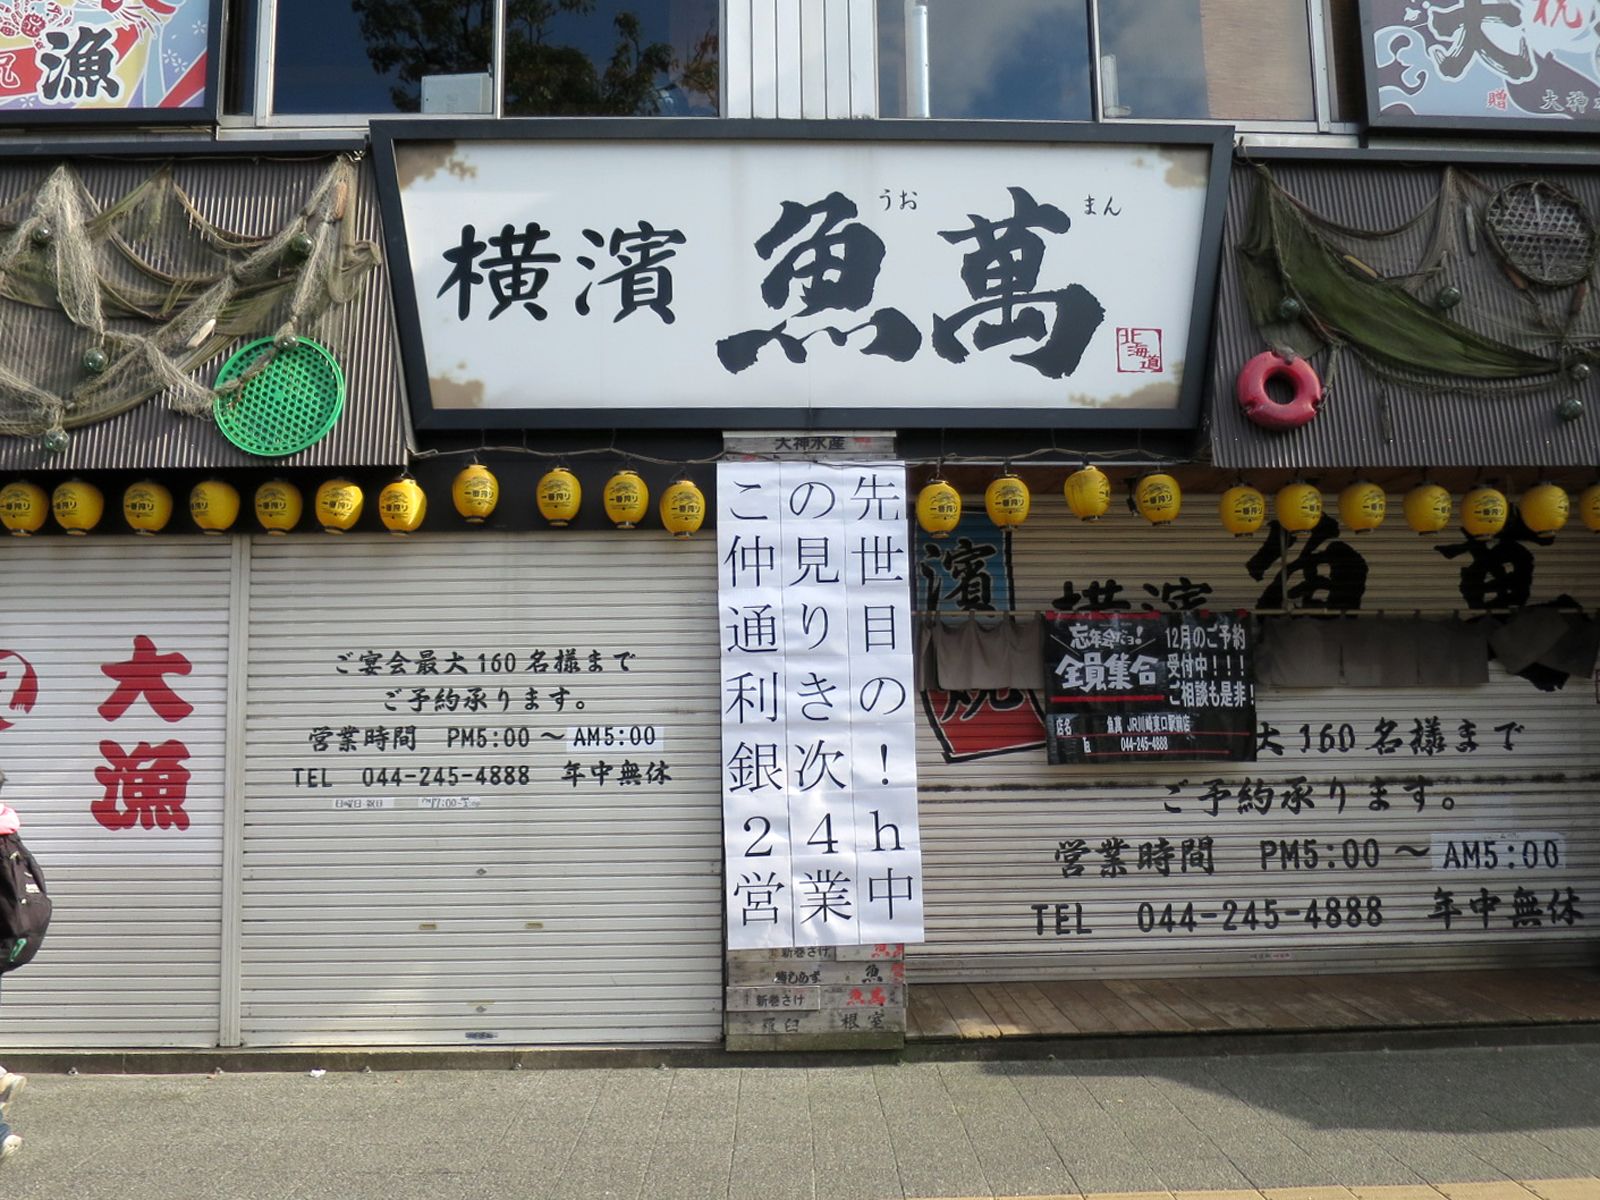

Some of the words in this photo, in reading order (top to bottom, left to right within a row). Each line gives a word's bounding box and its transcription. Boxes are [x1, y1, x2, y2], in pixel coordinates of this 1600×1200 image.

[879, 189, 918, 211] うお
[1083, 194, 1122, 216] まん
[1119, 331, 1159, 370] 北海道
[729, 474, 901, 521] この先
[724, 535, 904, 588] 仲見世
[726, 602, 898, 654] 通り目
[1055, 652, 1160, 693] 全員集合
[384, 687, 586, 712] ご予約承ります。
[725, 671, 907, 724] 利きの
[91, 635, 195, 831] 大漁
[308, 725, 417, 752] 営業時間
[293, 767, 334, 788] TEL
[362, 765, 530, 787] 044-245-4888
[560, 760, 673, 788] 年中無休
[1164, 773, 1456, 817] ご予約承ります。
[1055, 835, 1216, 879] 営業時間
[733, 867, 914, 927] 営業中
[1031, 902, 1093, 935] TEL
[1137, 896, 1384, 932] 044-245-4888
[1427, 886, 1585, 930] 年中無休
